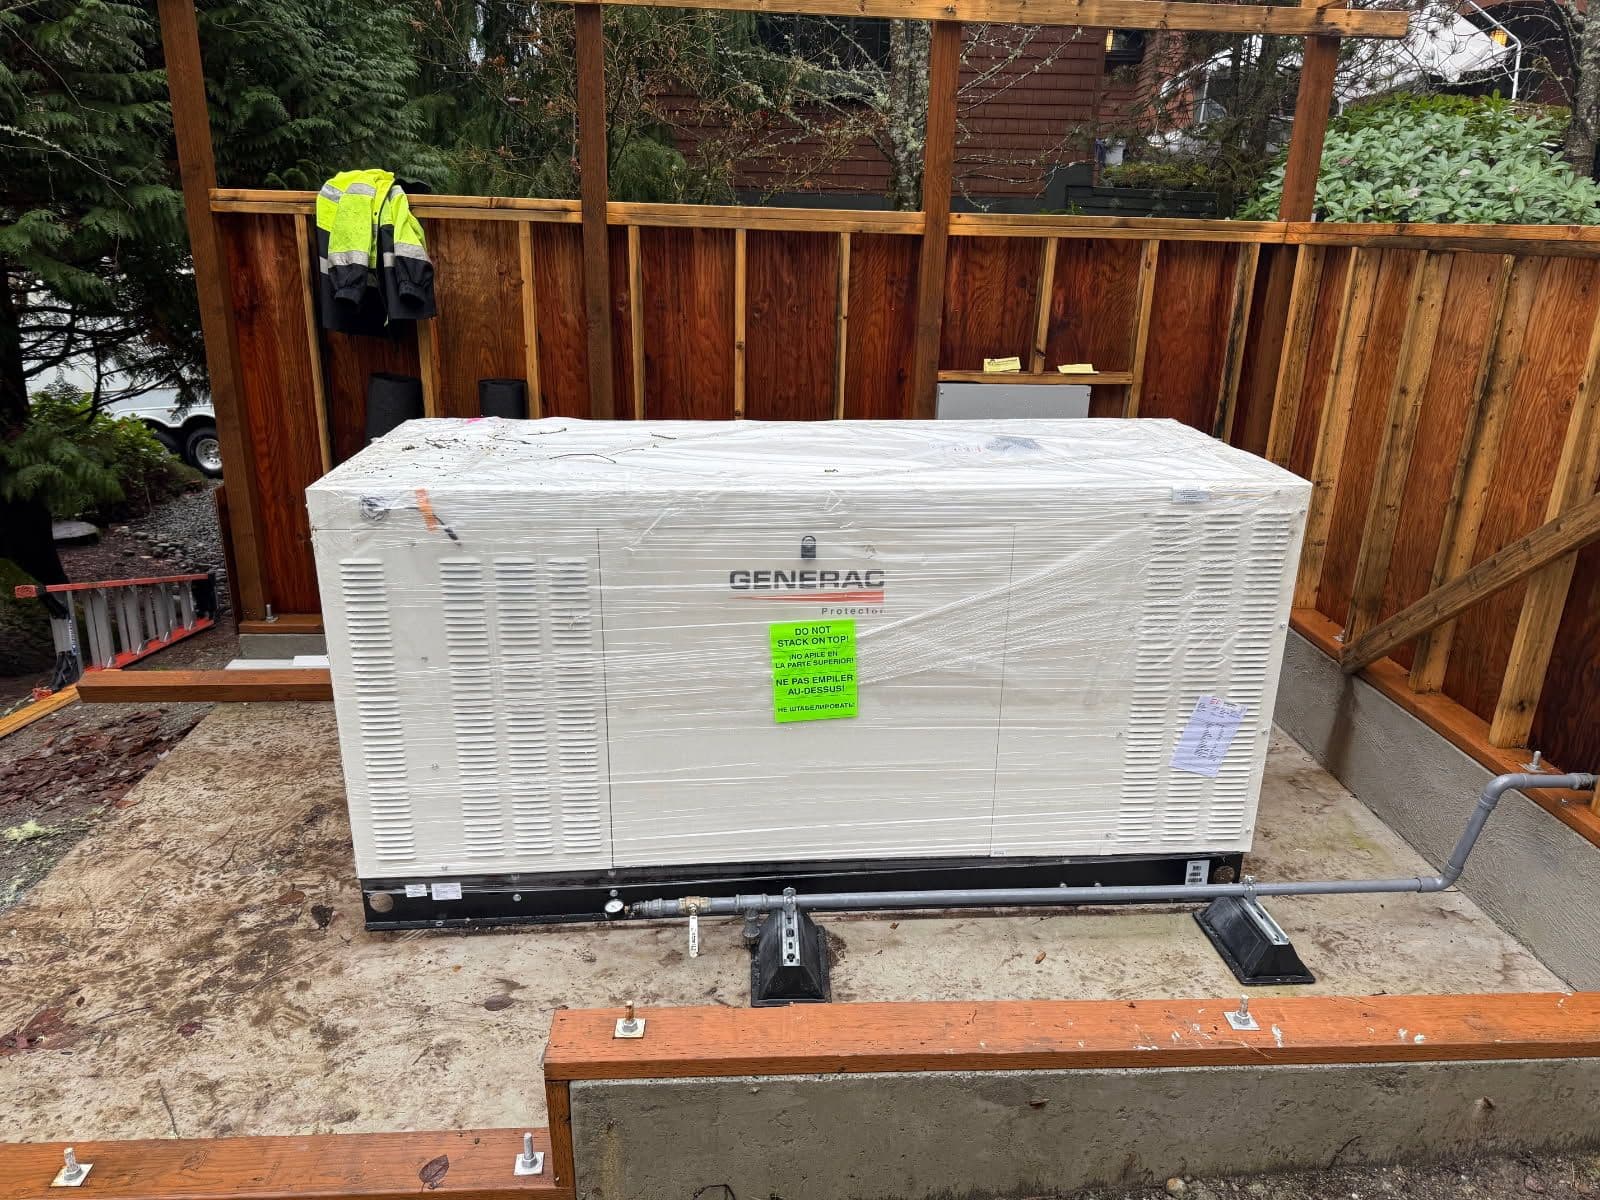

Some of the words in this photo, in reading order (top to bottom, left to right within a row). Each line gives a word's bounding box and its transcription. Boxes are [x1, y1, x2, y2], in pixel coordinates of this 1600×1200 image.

[729, 570, 885, 590] GENERAC
[795, 628, 809, 636] DO
[811, 626, 832, 635] NOT
[777, 638, 809, 648] STACK
[811, 636, 826, 645] ON
[827, 635, 849, 644] TOP!
[804, 651, 826, 660] APILE
[827, 650, 838, 658] EN
[775, 661, 786, 669] LA
[787, 659, 812, 669] PARTE
[813, 657, 854, 667] SUPERIOR!
[776, 678, 789, 687] NE
[791, 676, 810, 686] PAS
[812, 674, 853, 684] EMPILER
[787, 684, 845, 696] AU-DESSUS!
